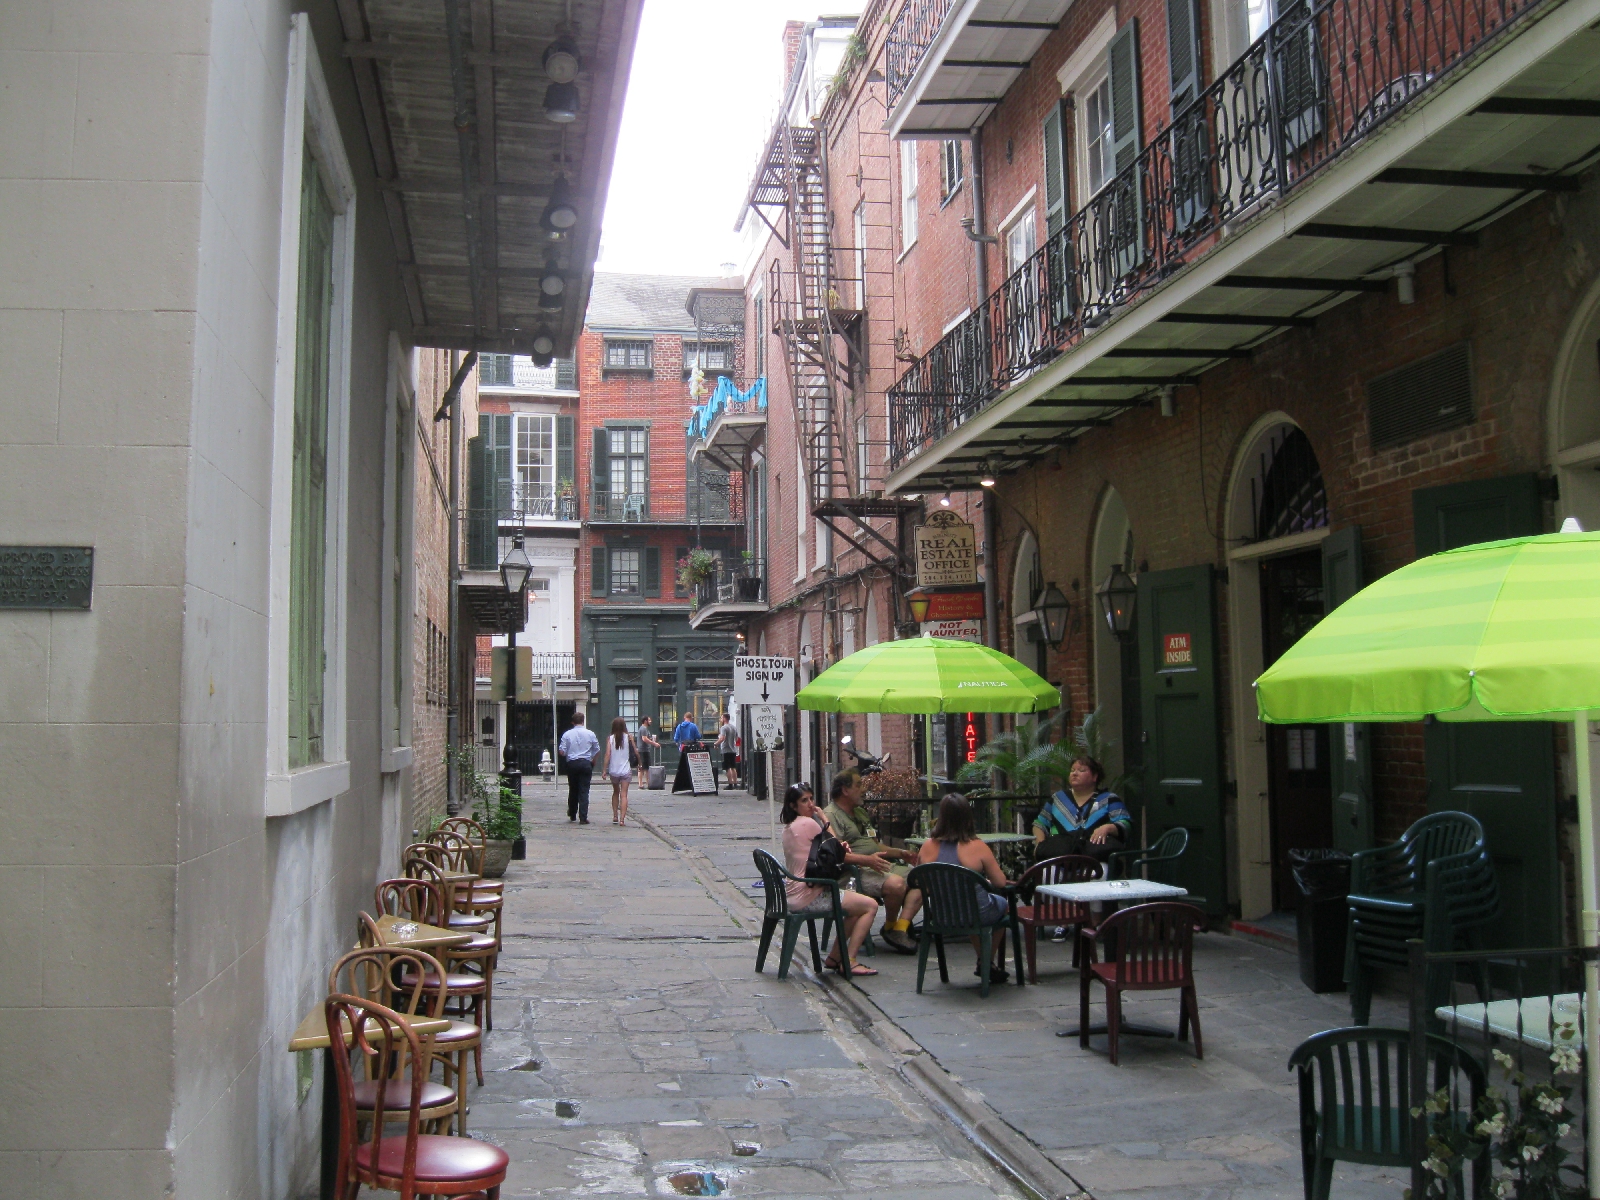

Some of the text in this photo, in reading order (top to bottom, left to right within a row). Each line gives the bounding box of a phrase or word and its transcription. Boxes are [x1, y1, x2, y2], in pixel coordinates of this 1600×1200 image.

[919, 537, 973, 549] REAL
[62, 553, 78, 562] BY
[919, 548, 973, 560] ESTATE
[924, 559, 970, 570] OFFICE
[1169, 636, 1187, 649] ATM
[1166, 650, 1191, 663] INSIDE
[735, 657, 794, 670] GHOST TOUR
[745, 670, 784, 682] SIGN UP
